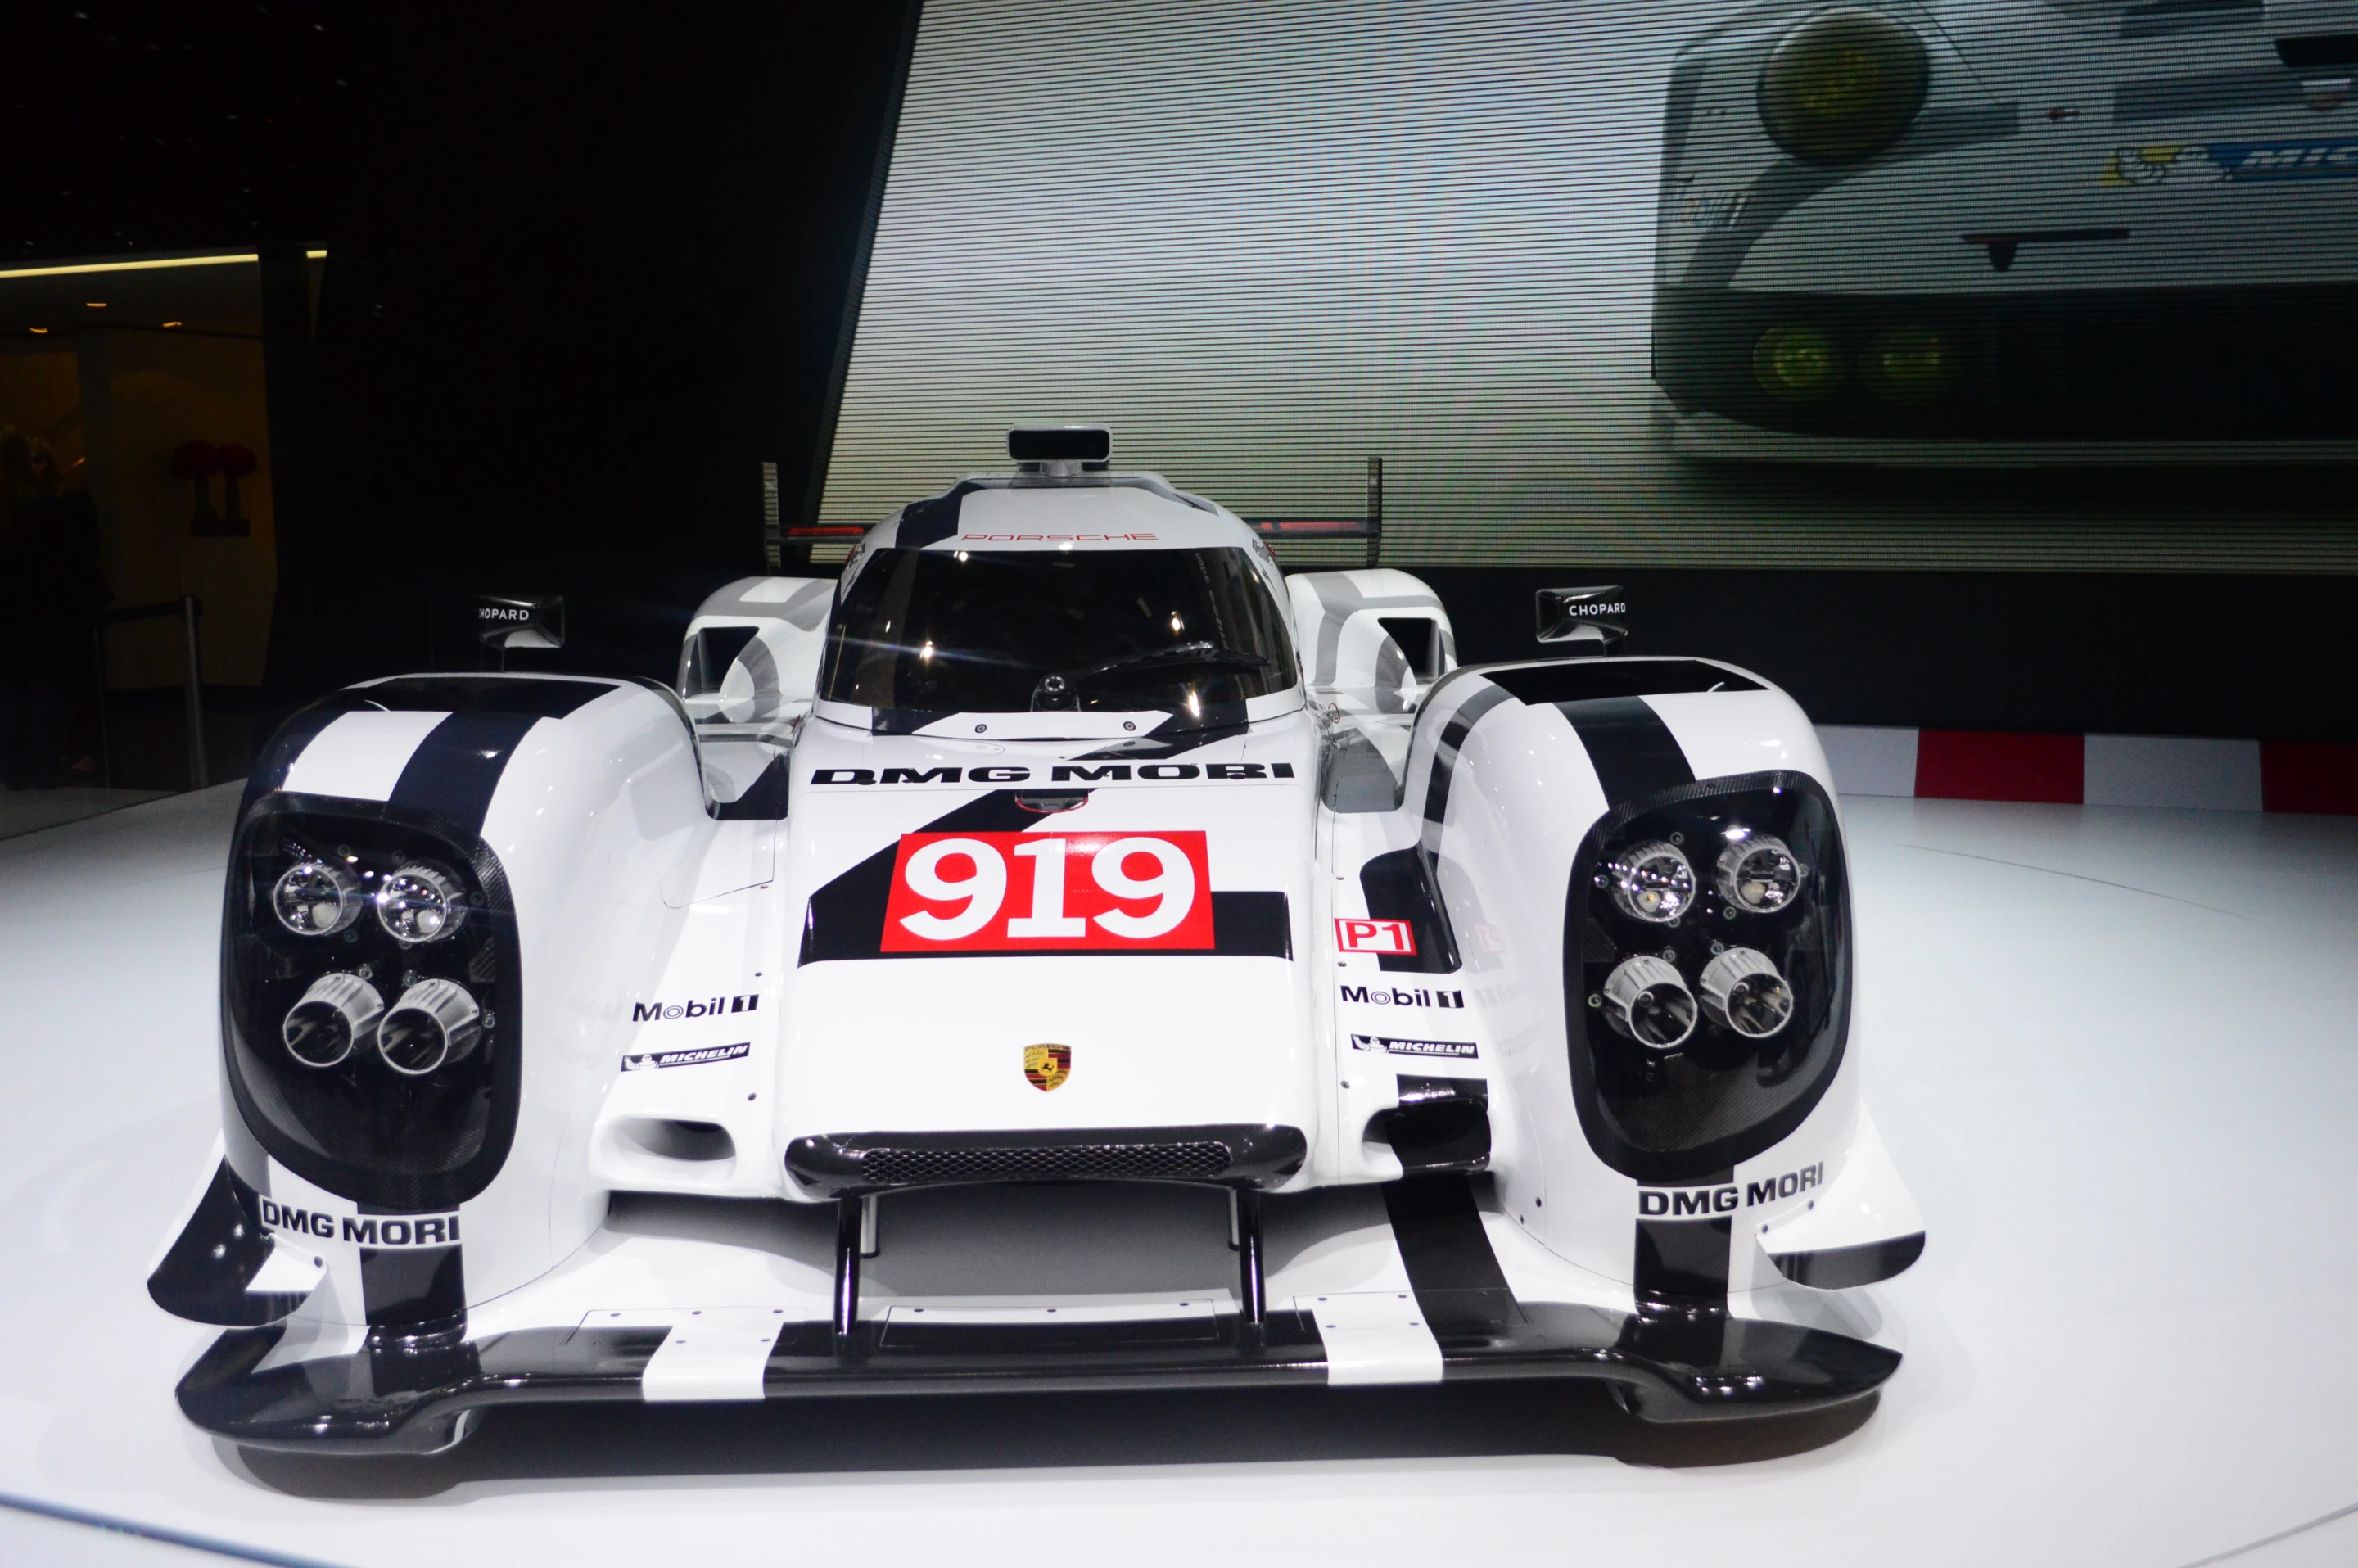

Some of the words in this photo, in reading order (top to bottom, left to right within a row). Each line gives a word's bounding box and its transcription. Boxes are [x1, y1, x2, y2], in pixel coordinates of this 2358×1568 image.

[1569, 603, 1626, 616] CHOPARD
[811, 766, 1031, 785] DMG
[1051, 763, 1294, 781] MORI
[899, 837, 1195, 941] 919
[1345, 921, 1405, 951] P1
[632, 996, 725, 1022] Mobil
[735, 994, 755, 1013] 1
[1340, 985, 1431, 1007] Mobil
[1439, 991, 1460, 1008] 1
[659, 1045, 748, 1064] MICHELIN
[1389, 1041, 1475, 1054] MICHELIN
[1638, 1186, 1738, 1215] DMG
[1746, 1161, 1823, 1207] MORI
[262, 1199, 335, 1238] DMG
[342, 1215, 460, 1245] MORI
